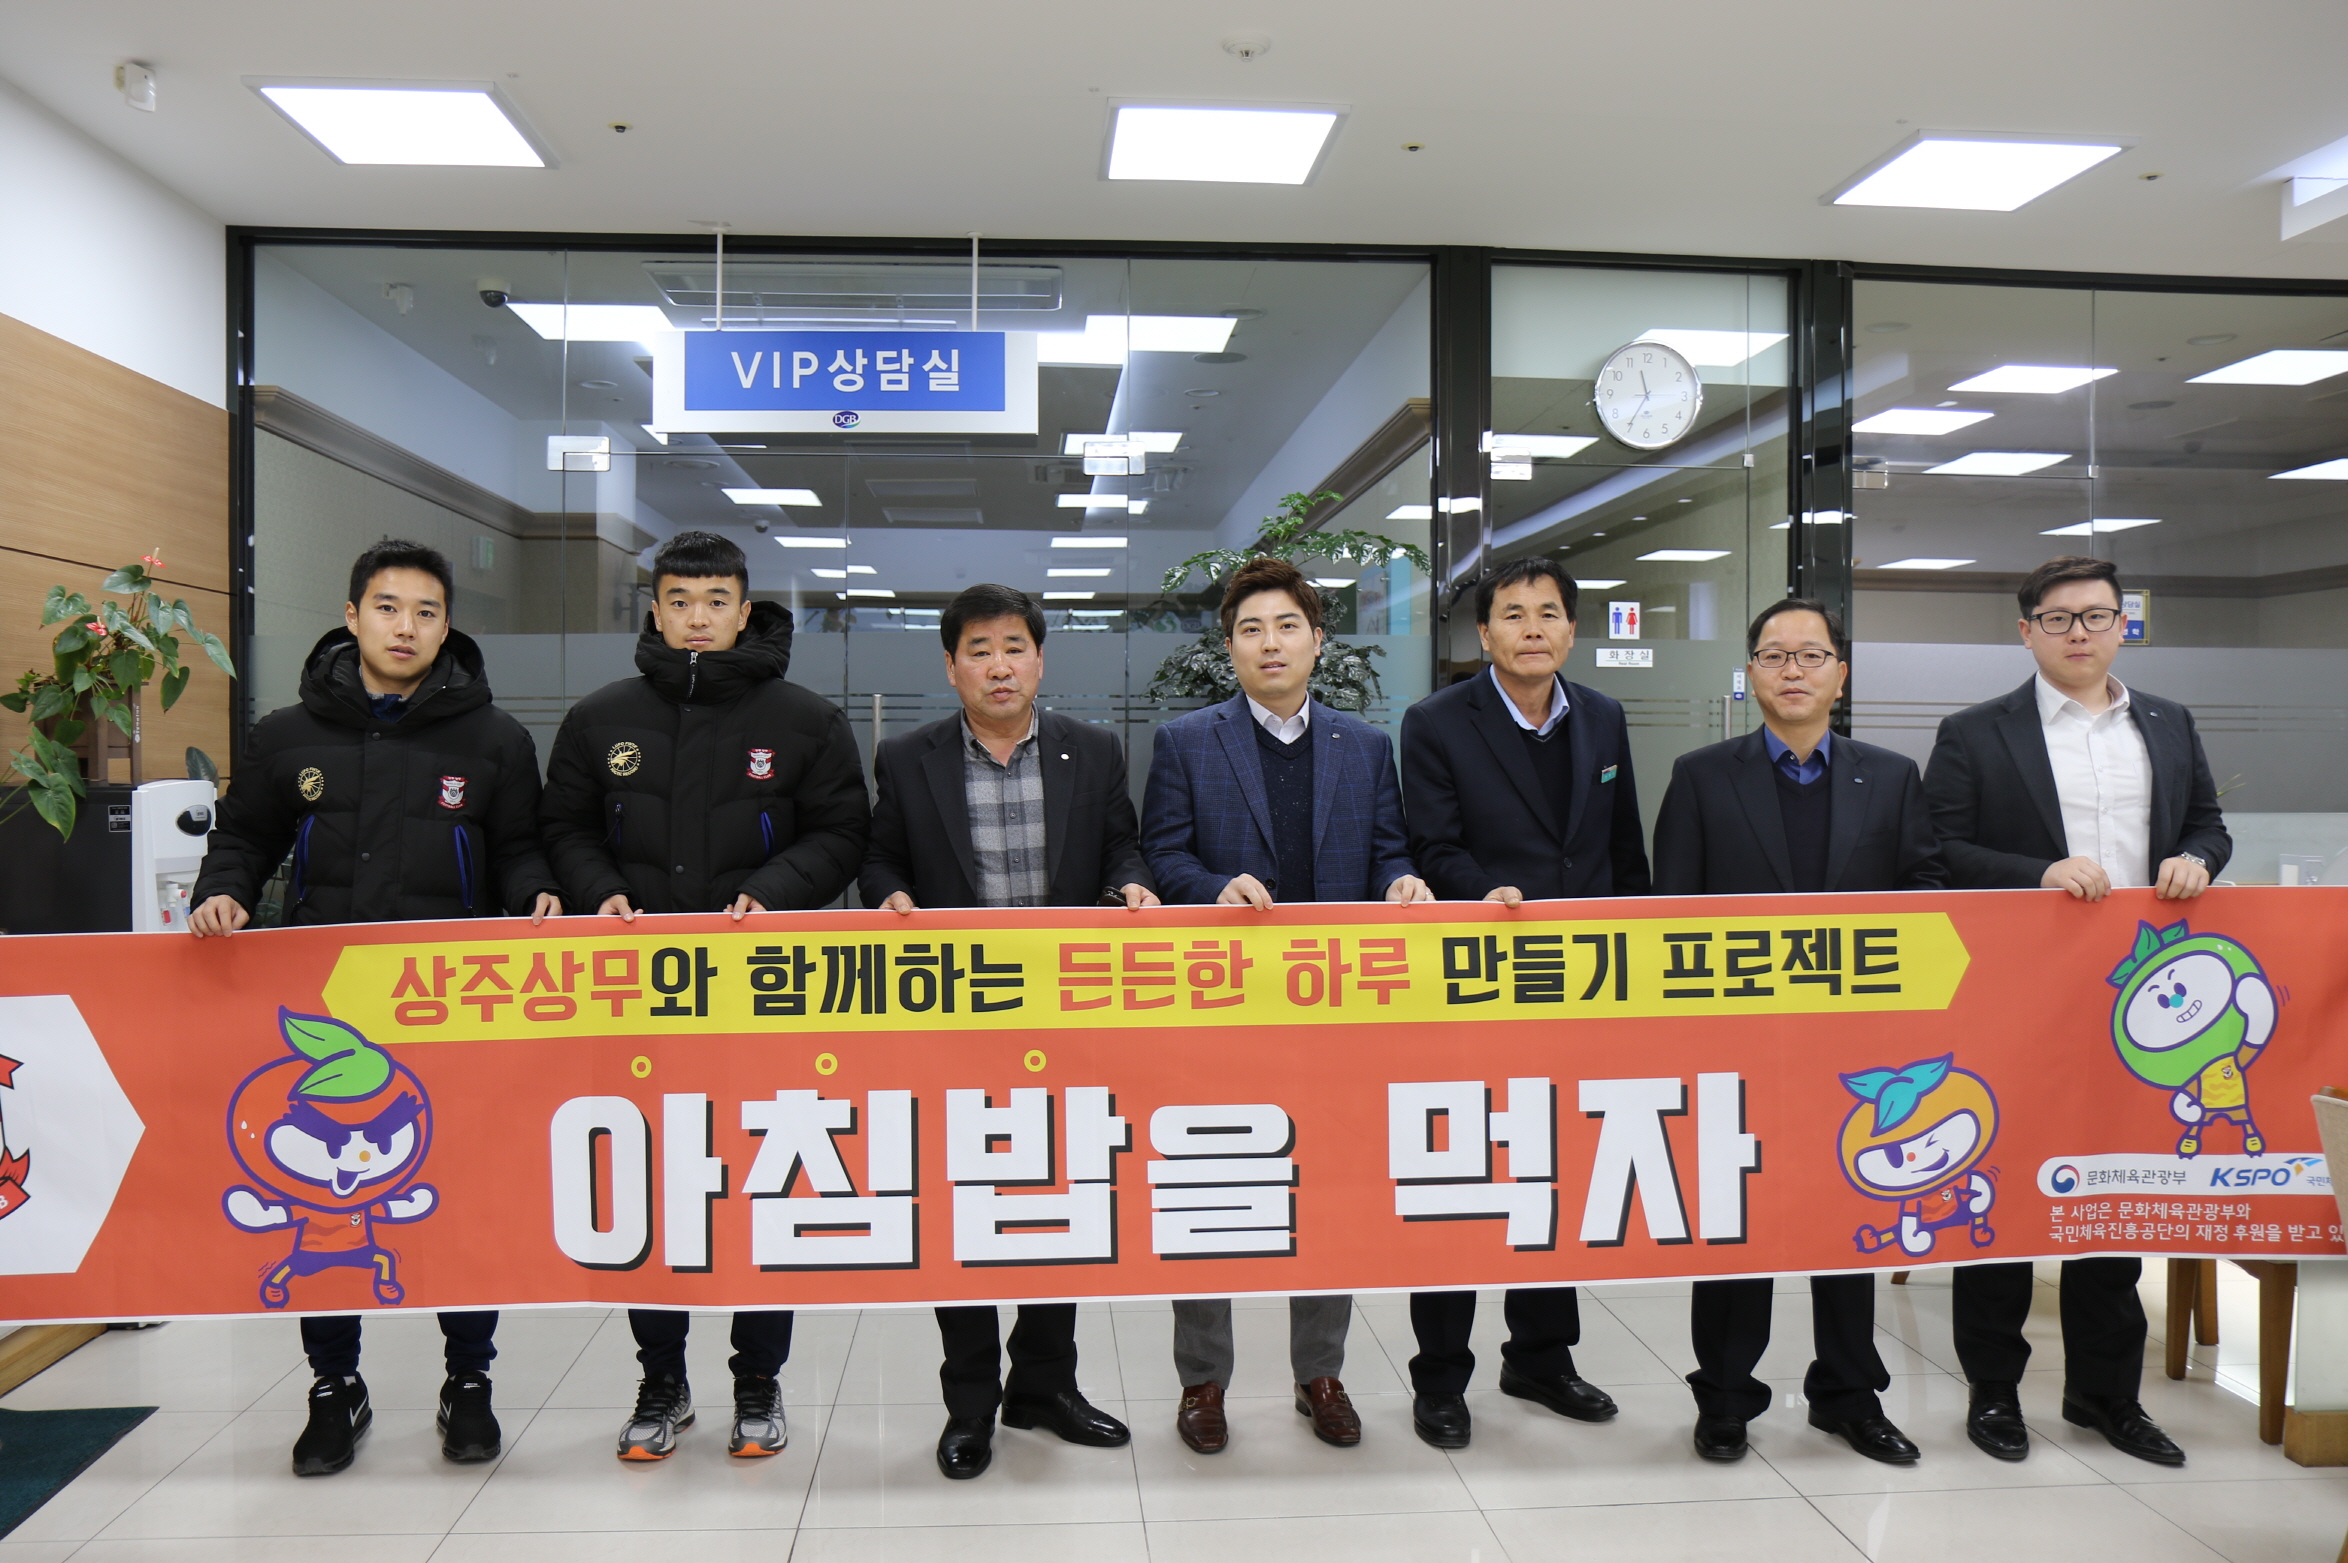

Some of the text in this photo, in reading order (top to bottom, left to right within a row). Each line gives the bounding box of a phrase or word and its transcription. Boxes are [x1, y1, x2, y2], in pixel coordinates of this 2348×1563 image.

[1626, 357, 1634, 368] 11
[1642, 353, 1653, 364] 12
[1663, 357, 1667, 368] 1
[1612, 370, 1623, 381] 10
[1675, 371, 1682, 382] 2
[1606, 388, 1614, 399] 9
[1681, 391, 1688, 402] 3
[834, 414, 857, 424] DGB
[1612, 408, 1618, 419] 8
[1675, 410, 1682, 420] 4
[1627, 423, 1633, 433] 7
[1643, 428, 1650, 439] 6
[1661, 423, 1668, 434] 5
[391, 927, 1902, 1027] 상주상무와 함께하는 든든한 하루 만들기 프로젝트
[550, 1072, 1762, 1272] 아침밥을 먹자
[2086, 1168, 2187, 1186] 문화체육관광부
[2210, 1166, 2291, 1187] KSPO
[2050, 1202, 2251, 1222] 본 사업은 문화체육관광부와
[2049, 1222, 2190, 1243] 국민체육진흥공단의
[2195, 1224, 2229, 1242] 재정
[2233, 1224, 2283, 1242] 후원을
[2287, 1224, 2322, 1242] 받고
